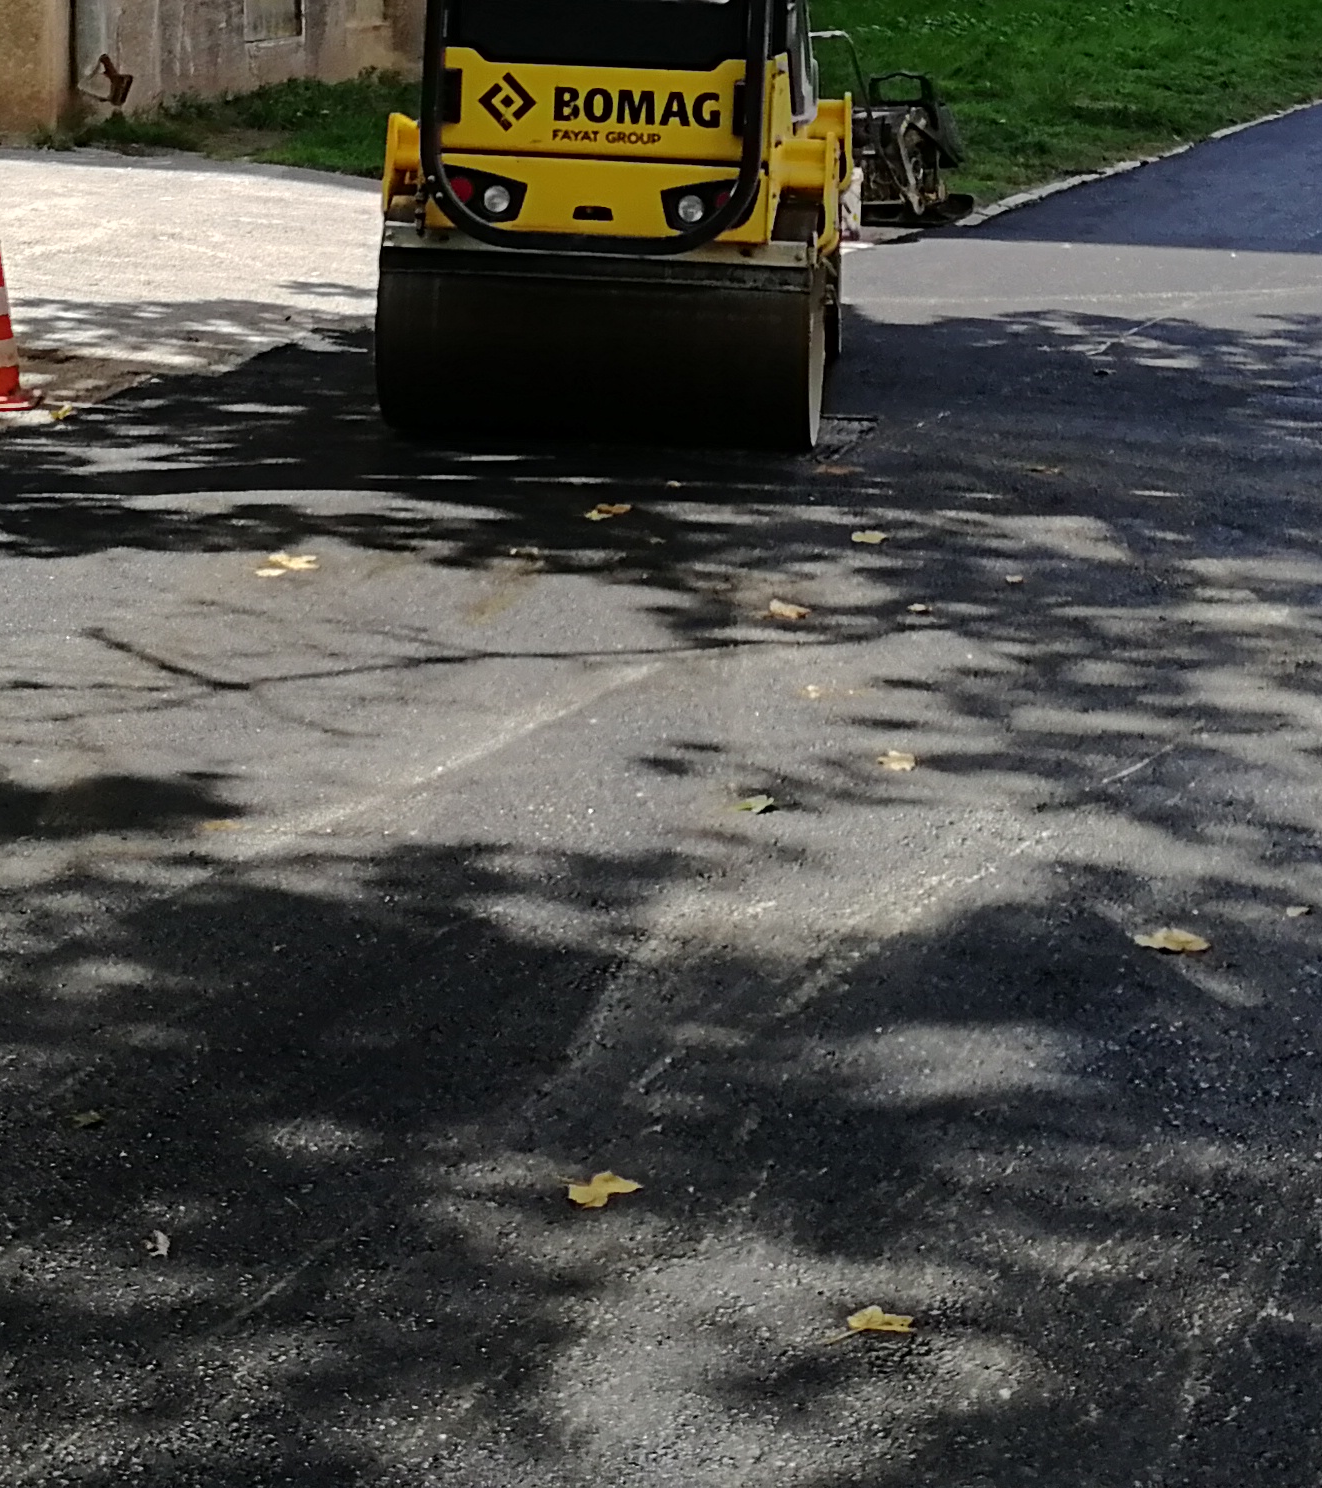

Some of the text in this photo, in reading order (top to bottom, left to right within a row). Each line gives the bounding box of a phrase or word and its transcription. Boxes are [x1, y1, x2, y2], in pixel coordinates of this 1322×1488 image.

[553, 86, 721, 129] BOMAG
[552, 129, 662, 144] FAYAT GROUP
